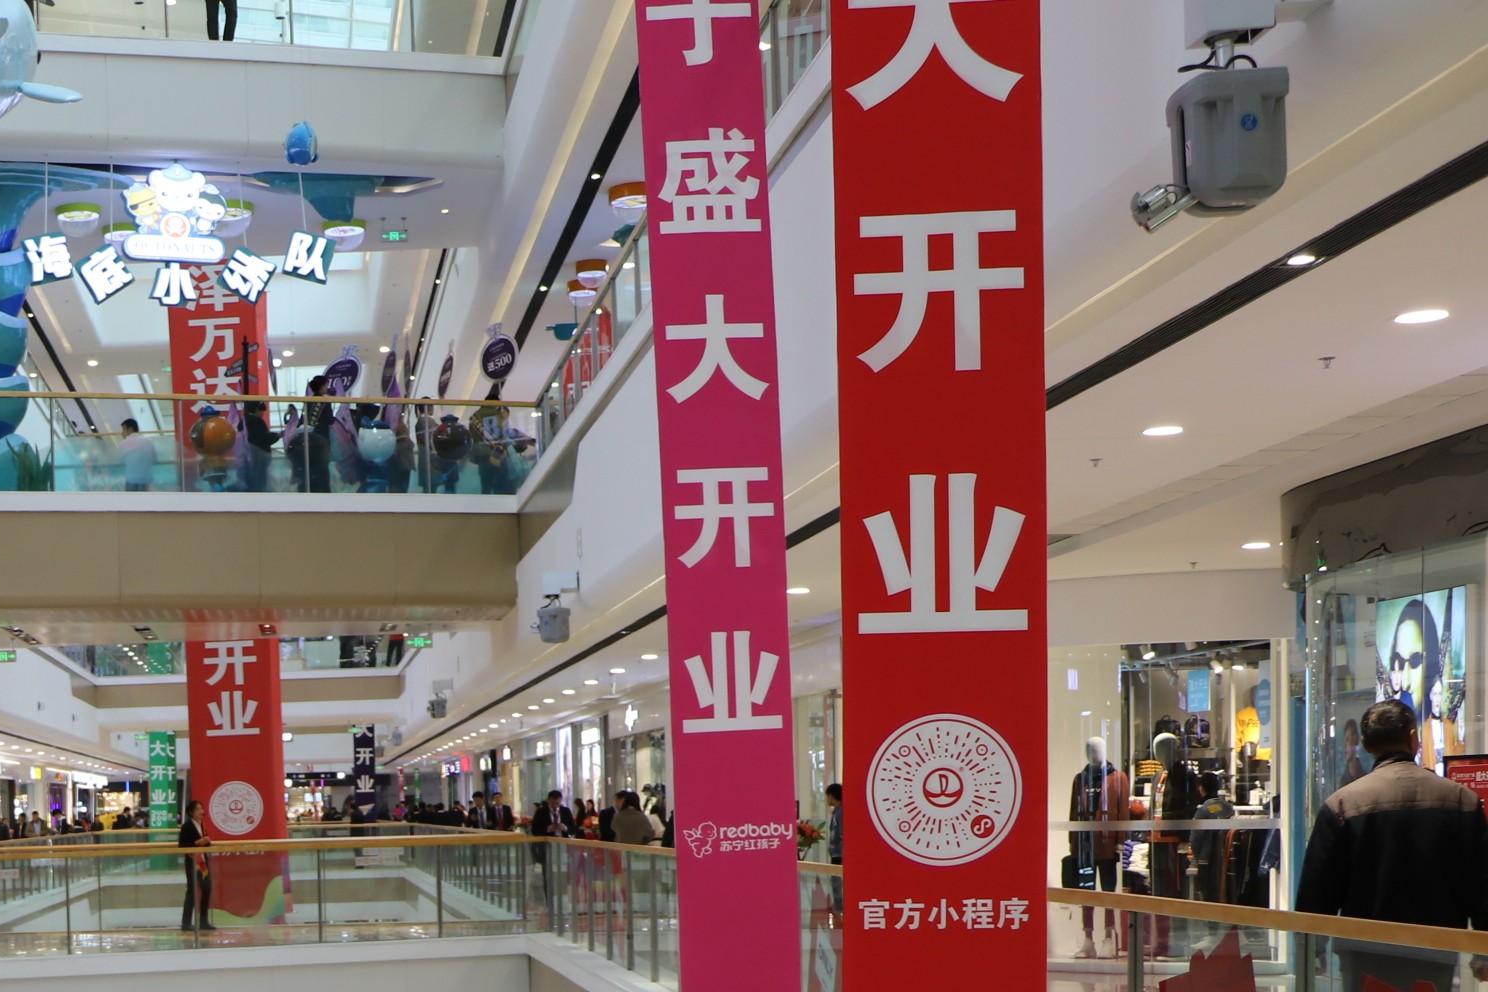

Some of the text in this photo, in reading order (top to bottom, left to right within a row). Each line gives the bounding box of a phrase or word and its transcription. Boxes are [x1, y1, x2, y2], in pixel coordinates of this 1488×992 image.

[23, 232, 327, 305] 海底小纵队
[845, 0, 1030, 634] 大开业
[203, 640, 260, 736] 开业
[150, 740, 167, 805] 大开业
[719, 822, 793, 840] redbaby
[719, 838, 781, 852] 苏宁红孩子
[858, 897, 1030, 930] 官方小程序
